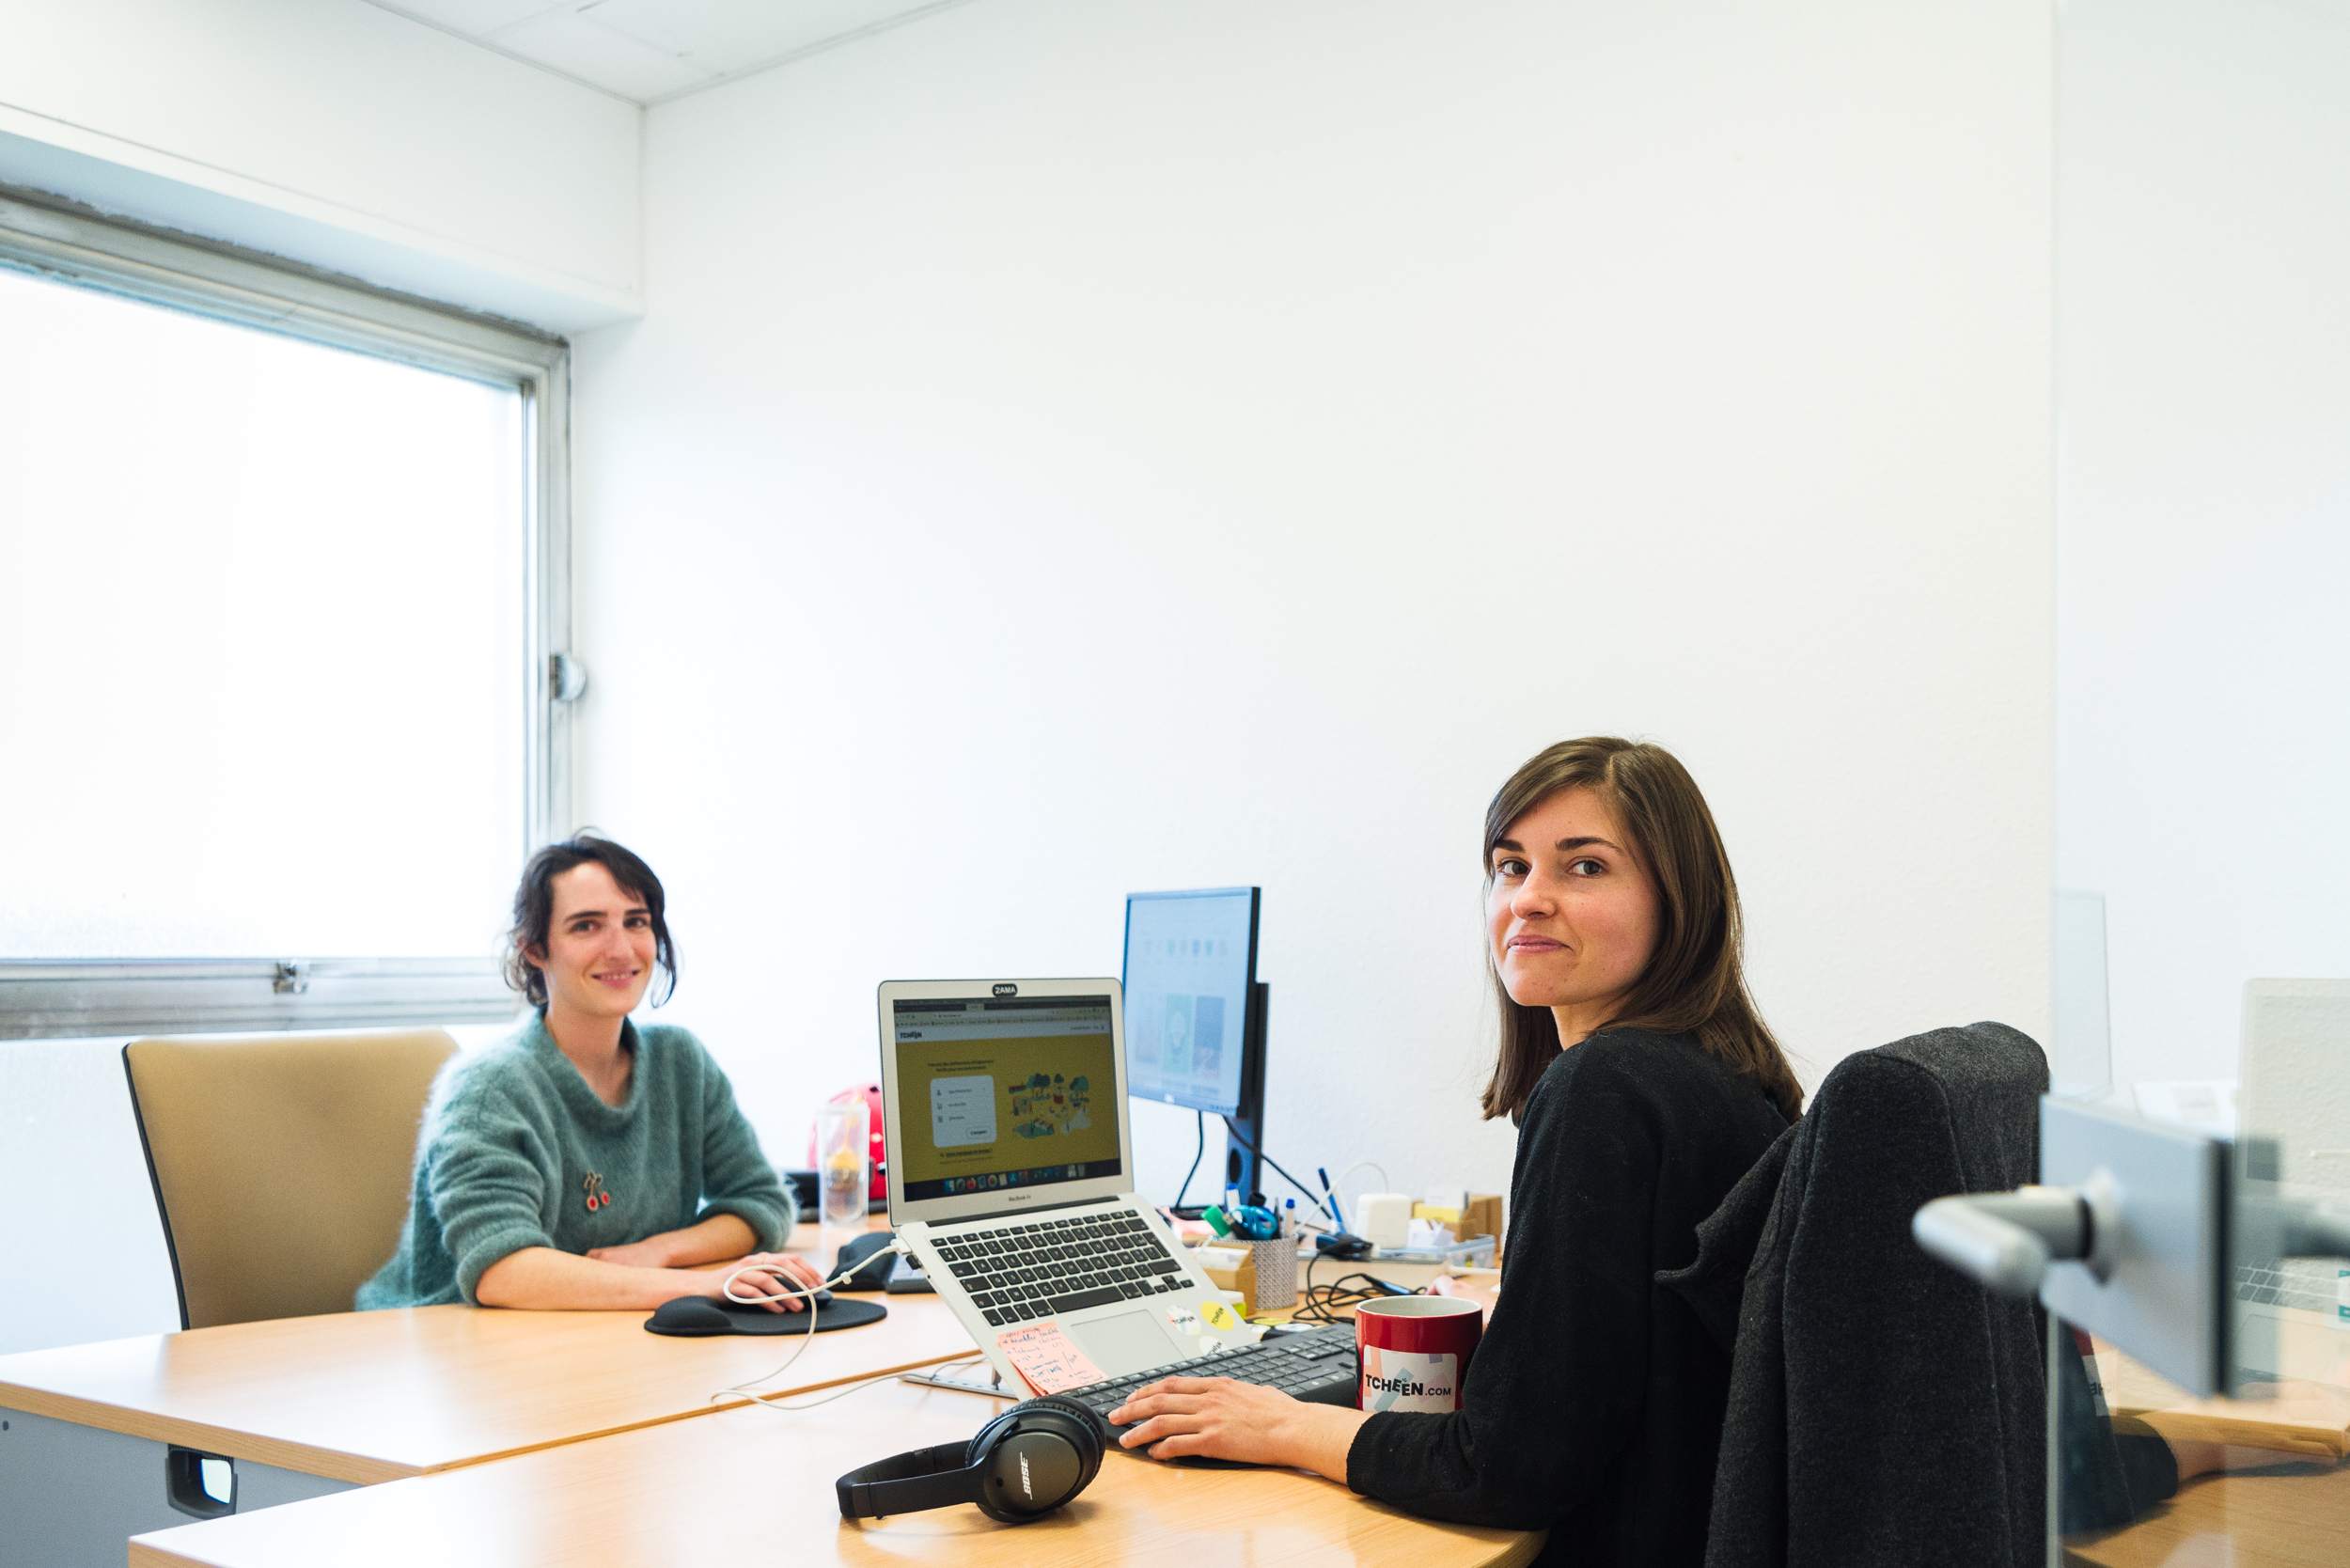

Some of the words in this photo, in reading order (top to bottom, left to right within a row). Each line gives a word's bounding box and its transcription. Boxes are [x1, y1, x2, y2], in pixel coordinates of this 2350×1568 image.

[1171, 1315, 1196, 1325] TCHEEN
[1211, 1307, 1225, 1325] TCHEEN
[1366, 1373, 1451, 1397] TCHEEN.COM
[1020, 1451, 1033, 1500] BOSE
